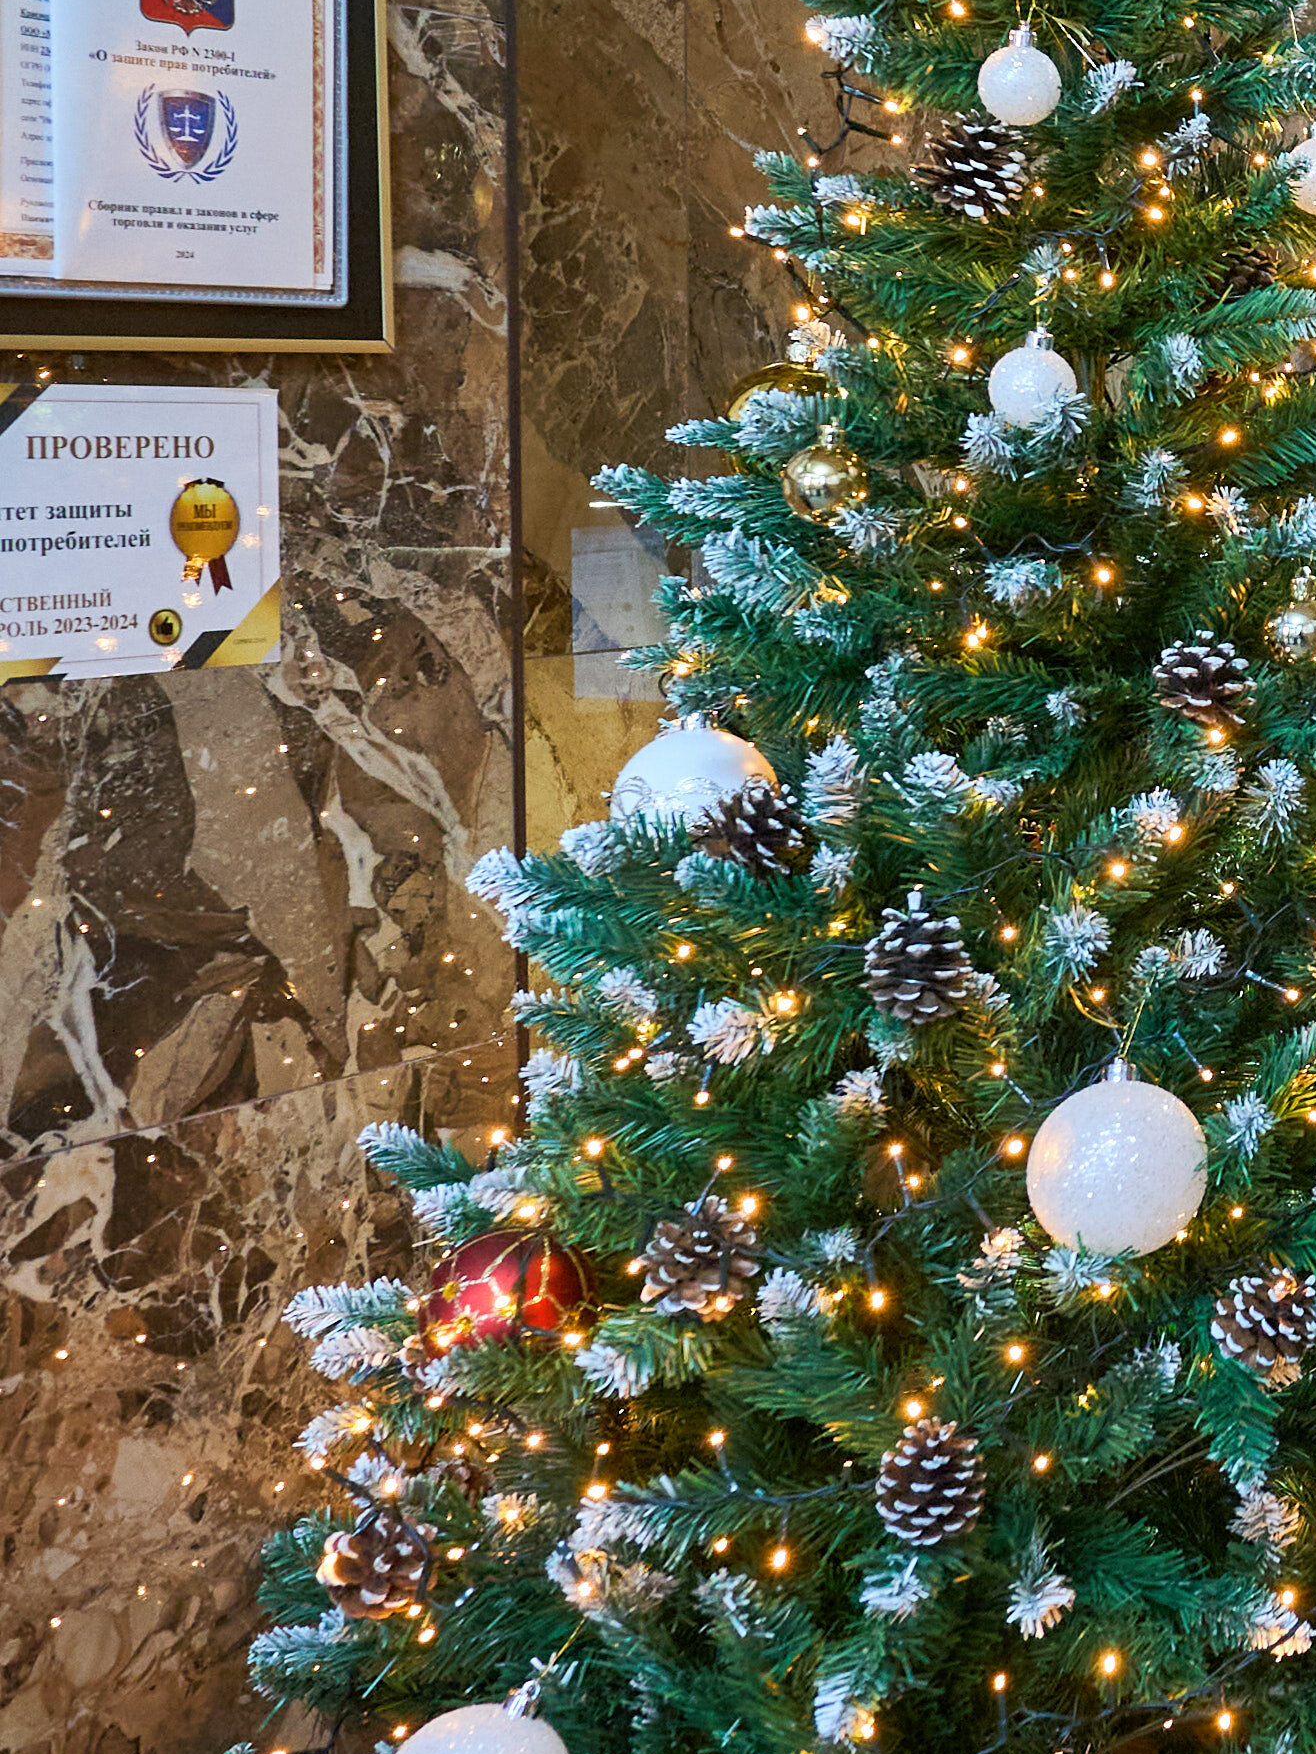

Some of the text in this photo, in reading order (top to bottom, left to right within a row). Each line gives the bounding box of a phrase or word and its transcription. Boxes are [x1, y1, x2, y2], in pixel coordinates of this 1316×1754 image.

[135, 40, 167, 54] Закон
[171, 44, 188, 56] РФ
[111, 53, 155, 67] защите
[160, 58, 187, 72] прав
[88, 199, 138, 214] Сборник
[142, 205, 182, 217] правил
[196, 208, 237, 218] законов
[249, 209, 279, 223] сфере
[112, 217, 163, 230] торговли
[176, 221, 226, 231] оказания
[229, 224, 258, 236] услуг
[26, 435, 215, 460] ПРОВЕРЕНО
[0, 504, 132, 521] тет защиты
[1, 529, 151, 556] потребителей
[0, 589, 111, 613] СТВЕННЫЙ
[54, 614, 138, 634] 2023-2024
